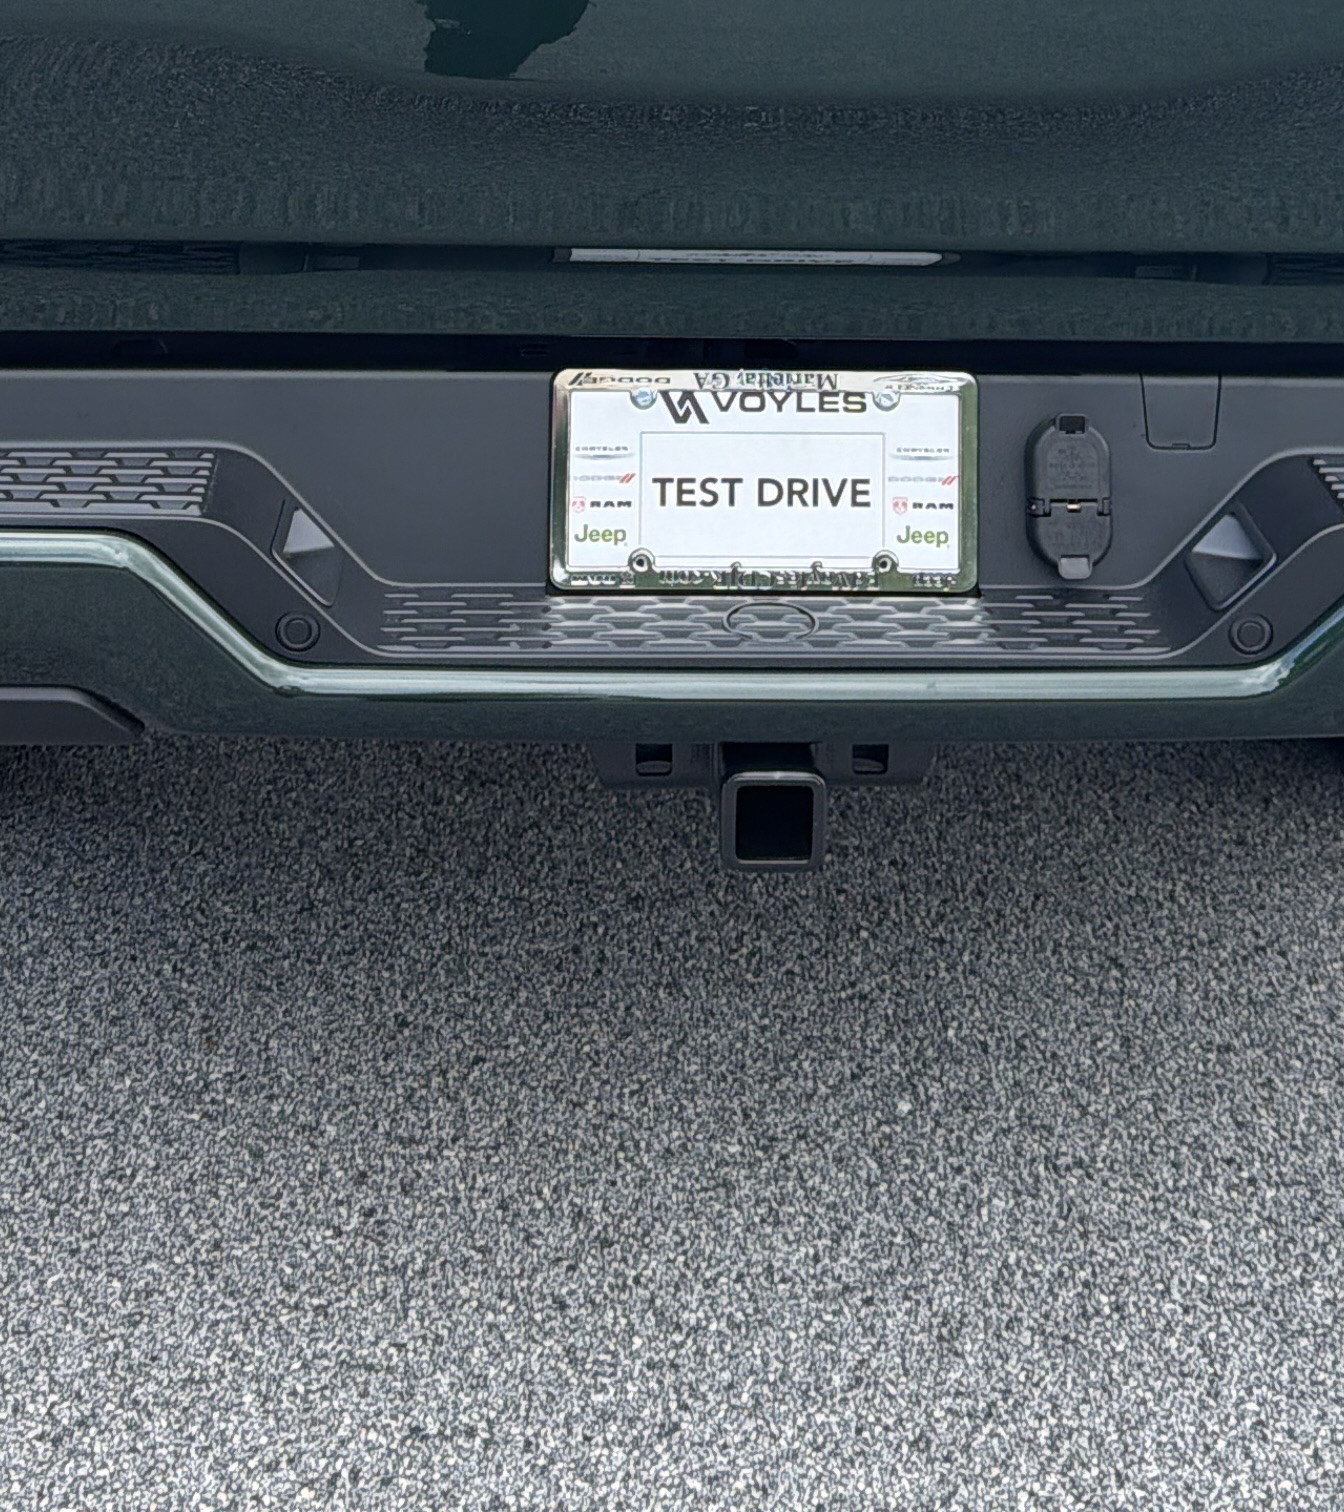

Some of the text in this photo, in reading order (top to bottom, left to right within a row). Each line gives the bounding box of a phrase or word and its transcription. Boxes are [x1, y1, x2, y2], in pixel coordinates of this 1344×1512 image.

[692, 372, 731, 390] GA
[714, 391, 867, 414] VOYLES
[651, 477, 872, 508] TEST DRIVE
[590, 500, 633, 508] RAM
[912, 502, 955, 510] RAM
[574, 524, 627, 545] Jeep
[896, 525, 950, 547] Jeep
